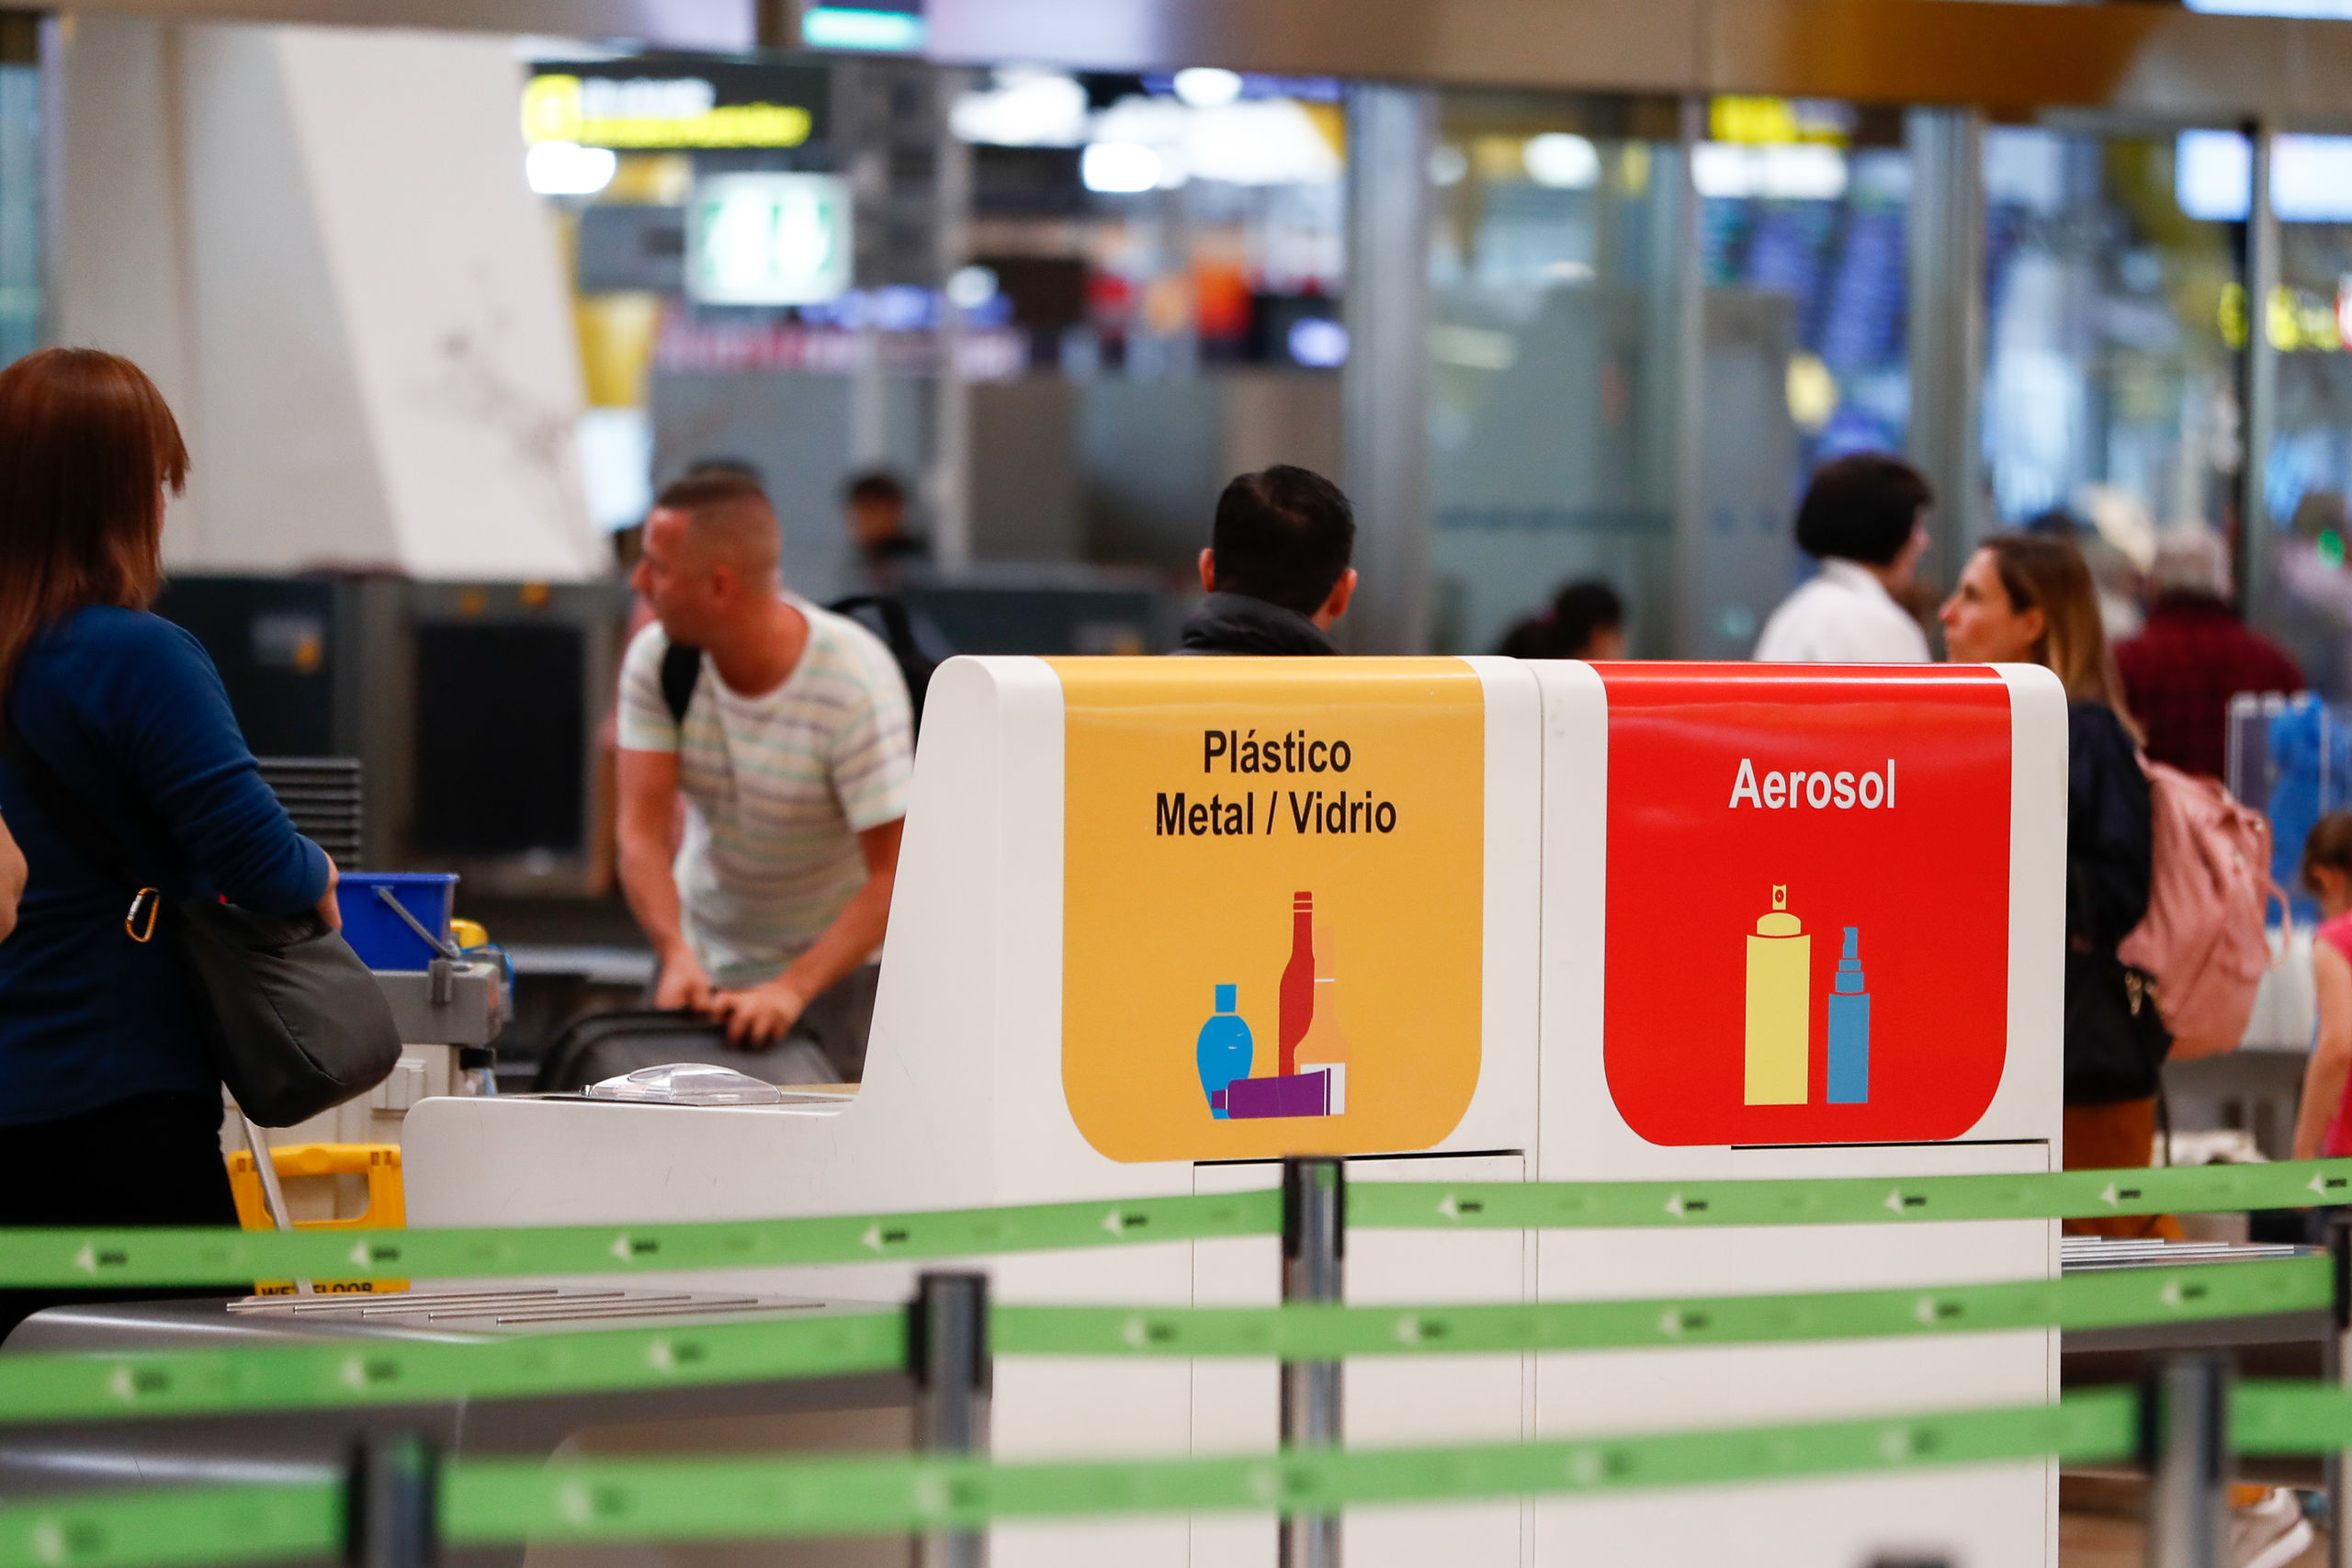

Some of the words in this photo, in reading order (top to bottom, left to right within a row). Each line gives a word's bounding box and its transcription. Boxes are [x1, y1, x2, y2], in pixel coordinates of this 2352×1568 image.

[1204, 728, 1351, 773] Plástico
[1728, 758, 1895, 809] Aerosol
[1156, 791, 1255, 836] Metal
[1266, 790, 1279, 835] /
[1288, 790, 1397, 834] Vidrio
